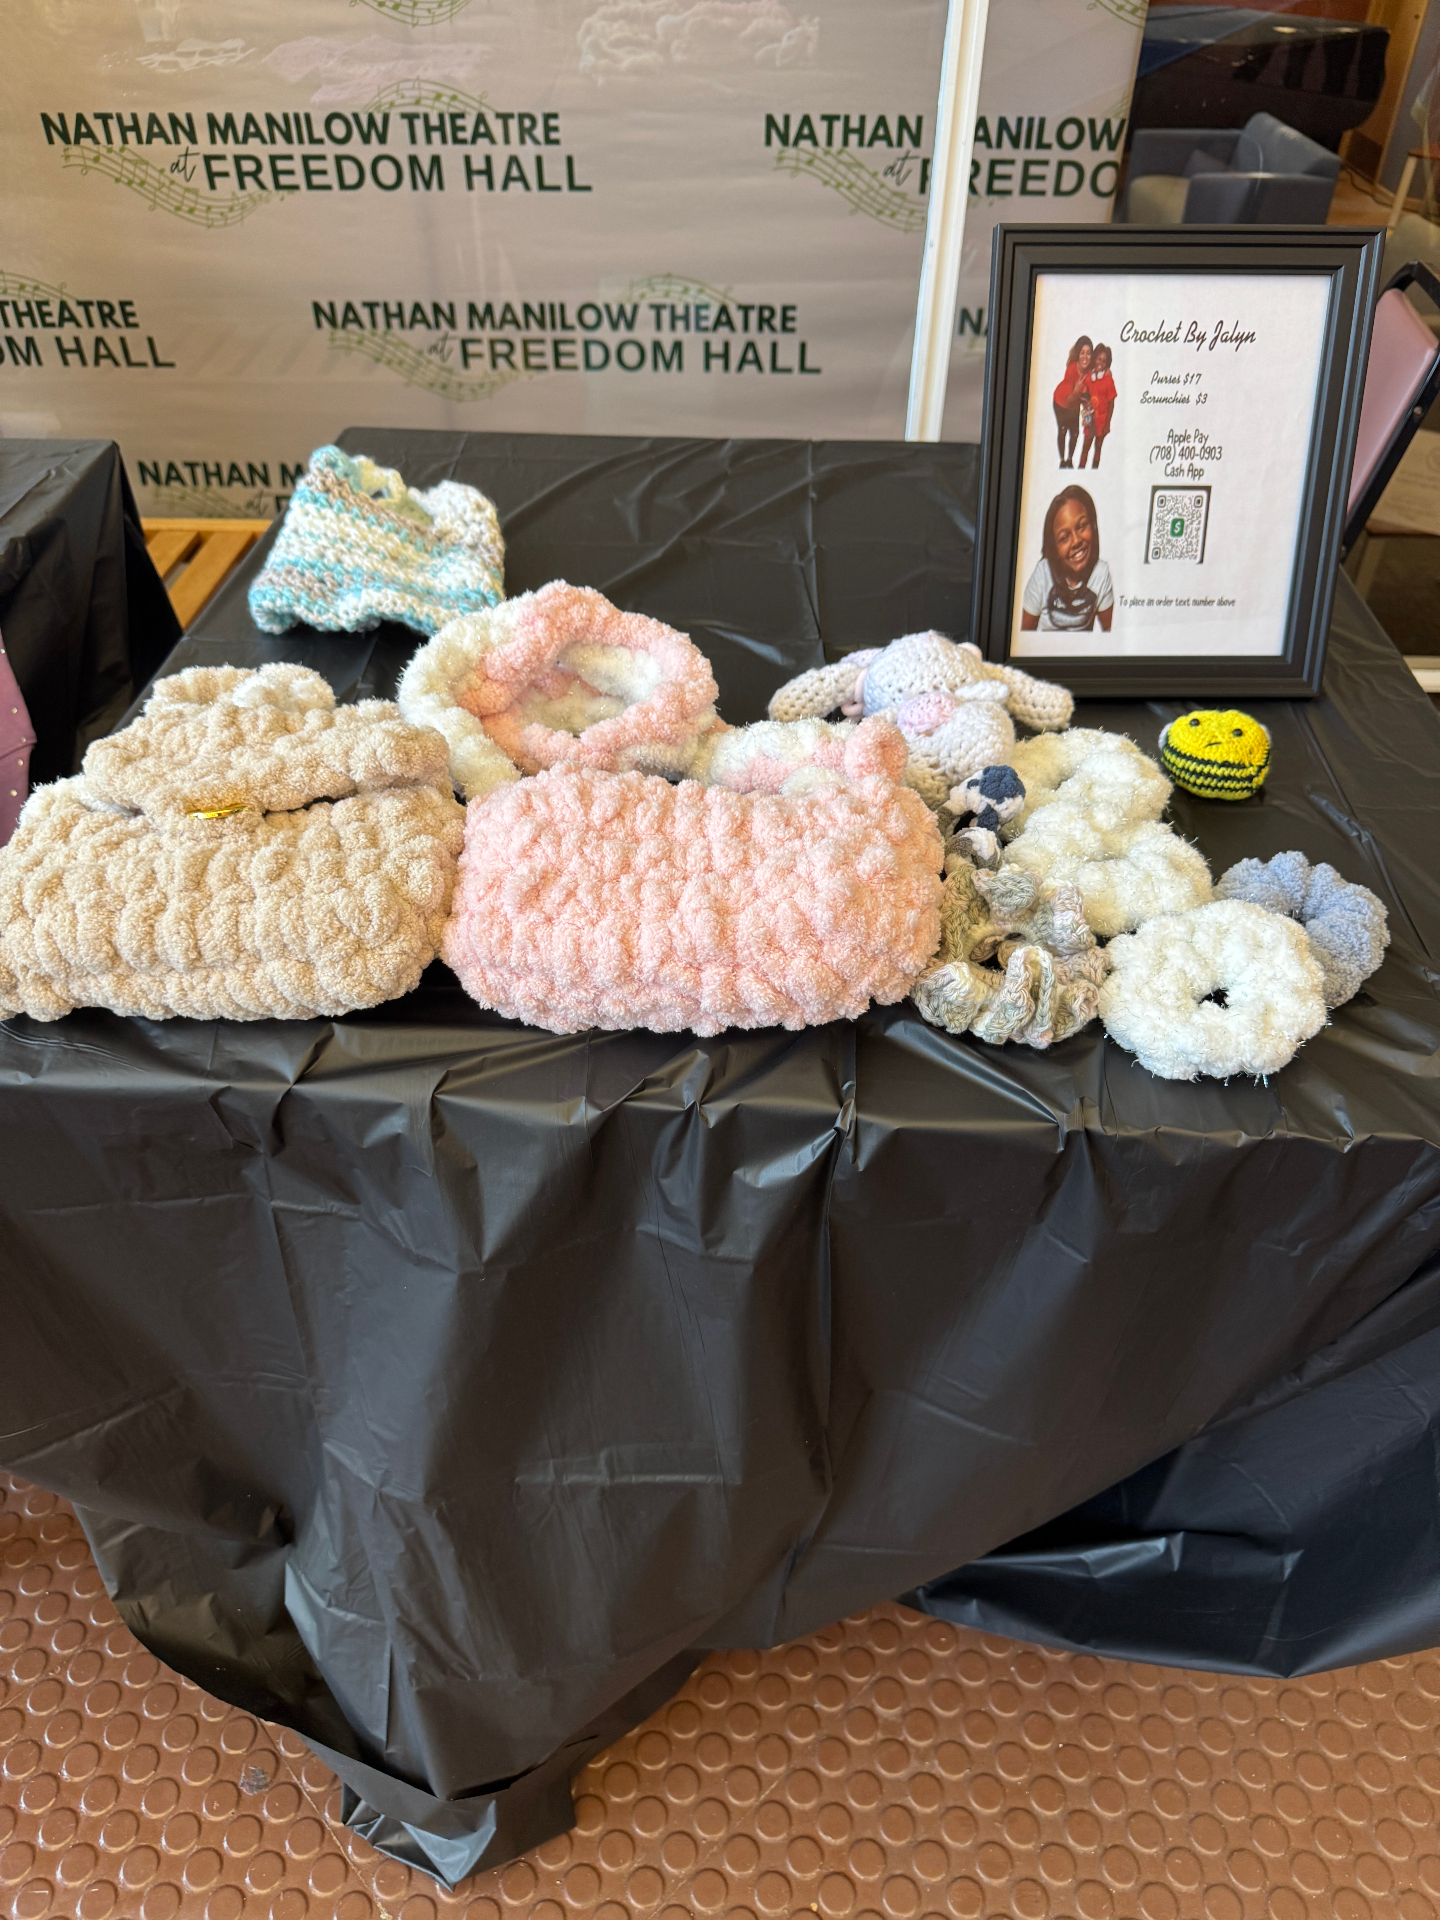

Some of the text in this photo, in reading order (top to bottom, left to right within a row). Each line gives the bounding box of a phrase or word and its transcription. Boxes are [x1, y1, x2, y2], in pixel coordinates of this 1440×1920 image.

[40, 111, 561, 145] NATHAN MANILOW THEATRE
[764, 113, 1126, 151] NATHAN ANILOW
[170, 146, 592, 192] at FREEDOM HALL
[882, 149, 920, 187] at
[0, 300, 140, 329] THEATRE
[312, 301, 798, 333] NATHAN MANILOW THEATRE
[1120, 319, 1256, 352] Crochet By Jalyn
[55, 335, 176, 368] HALL
[460, 338, 683, 373] FREEDOM
[703, 340, 822, 374] HALL
[1151, 370, 1202, 385] Purses $17
[1140, 390, 1208, 405] Scrunchies $3
[1167, 428, 1209, 447] Apple Pay
[1149, 445, 1222, 464] (708) 400-0903
[137, 460, 272, 487] NATHAN
[1164, 463, 1204, 481] Cash App
[1119, 595, 1128, 607] To
[1129, 597, 1145, 609] place
[1155, 597, 1174, 607] order
[1175, 597, 1190, 607] text
[1191, 597, 1215, 607] number
[1216, 596, 1236, 607] above
